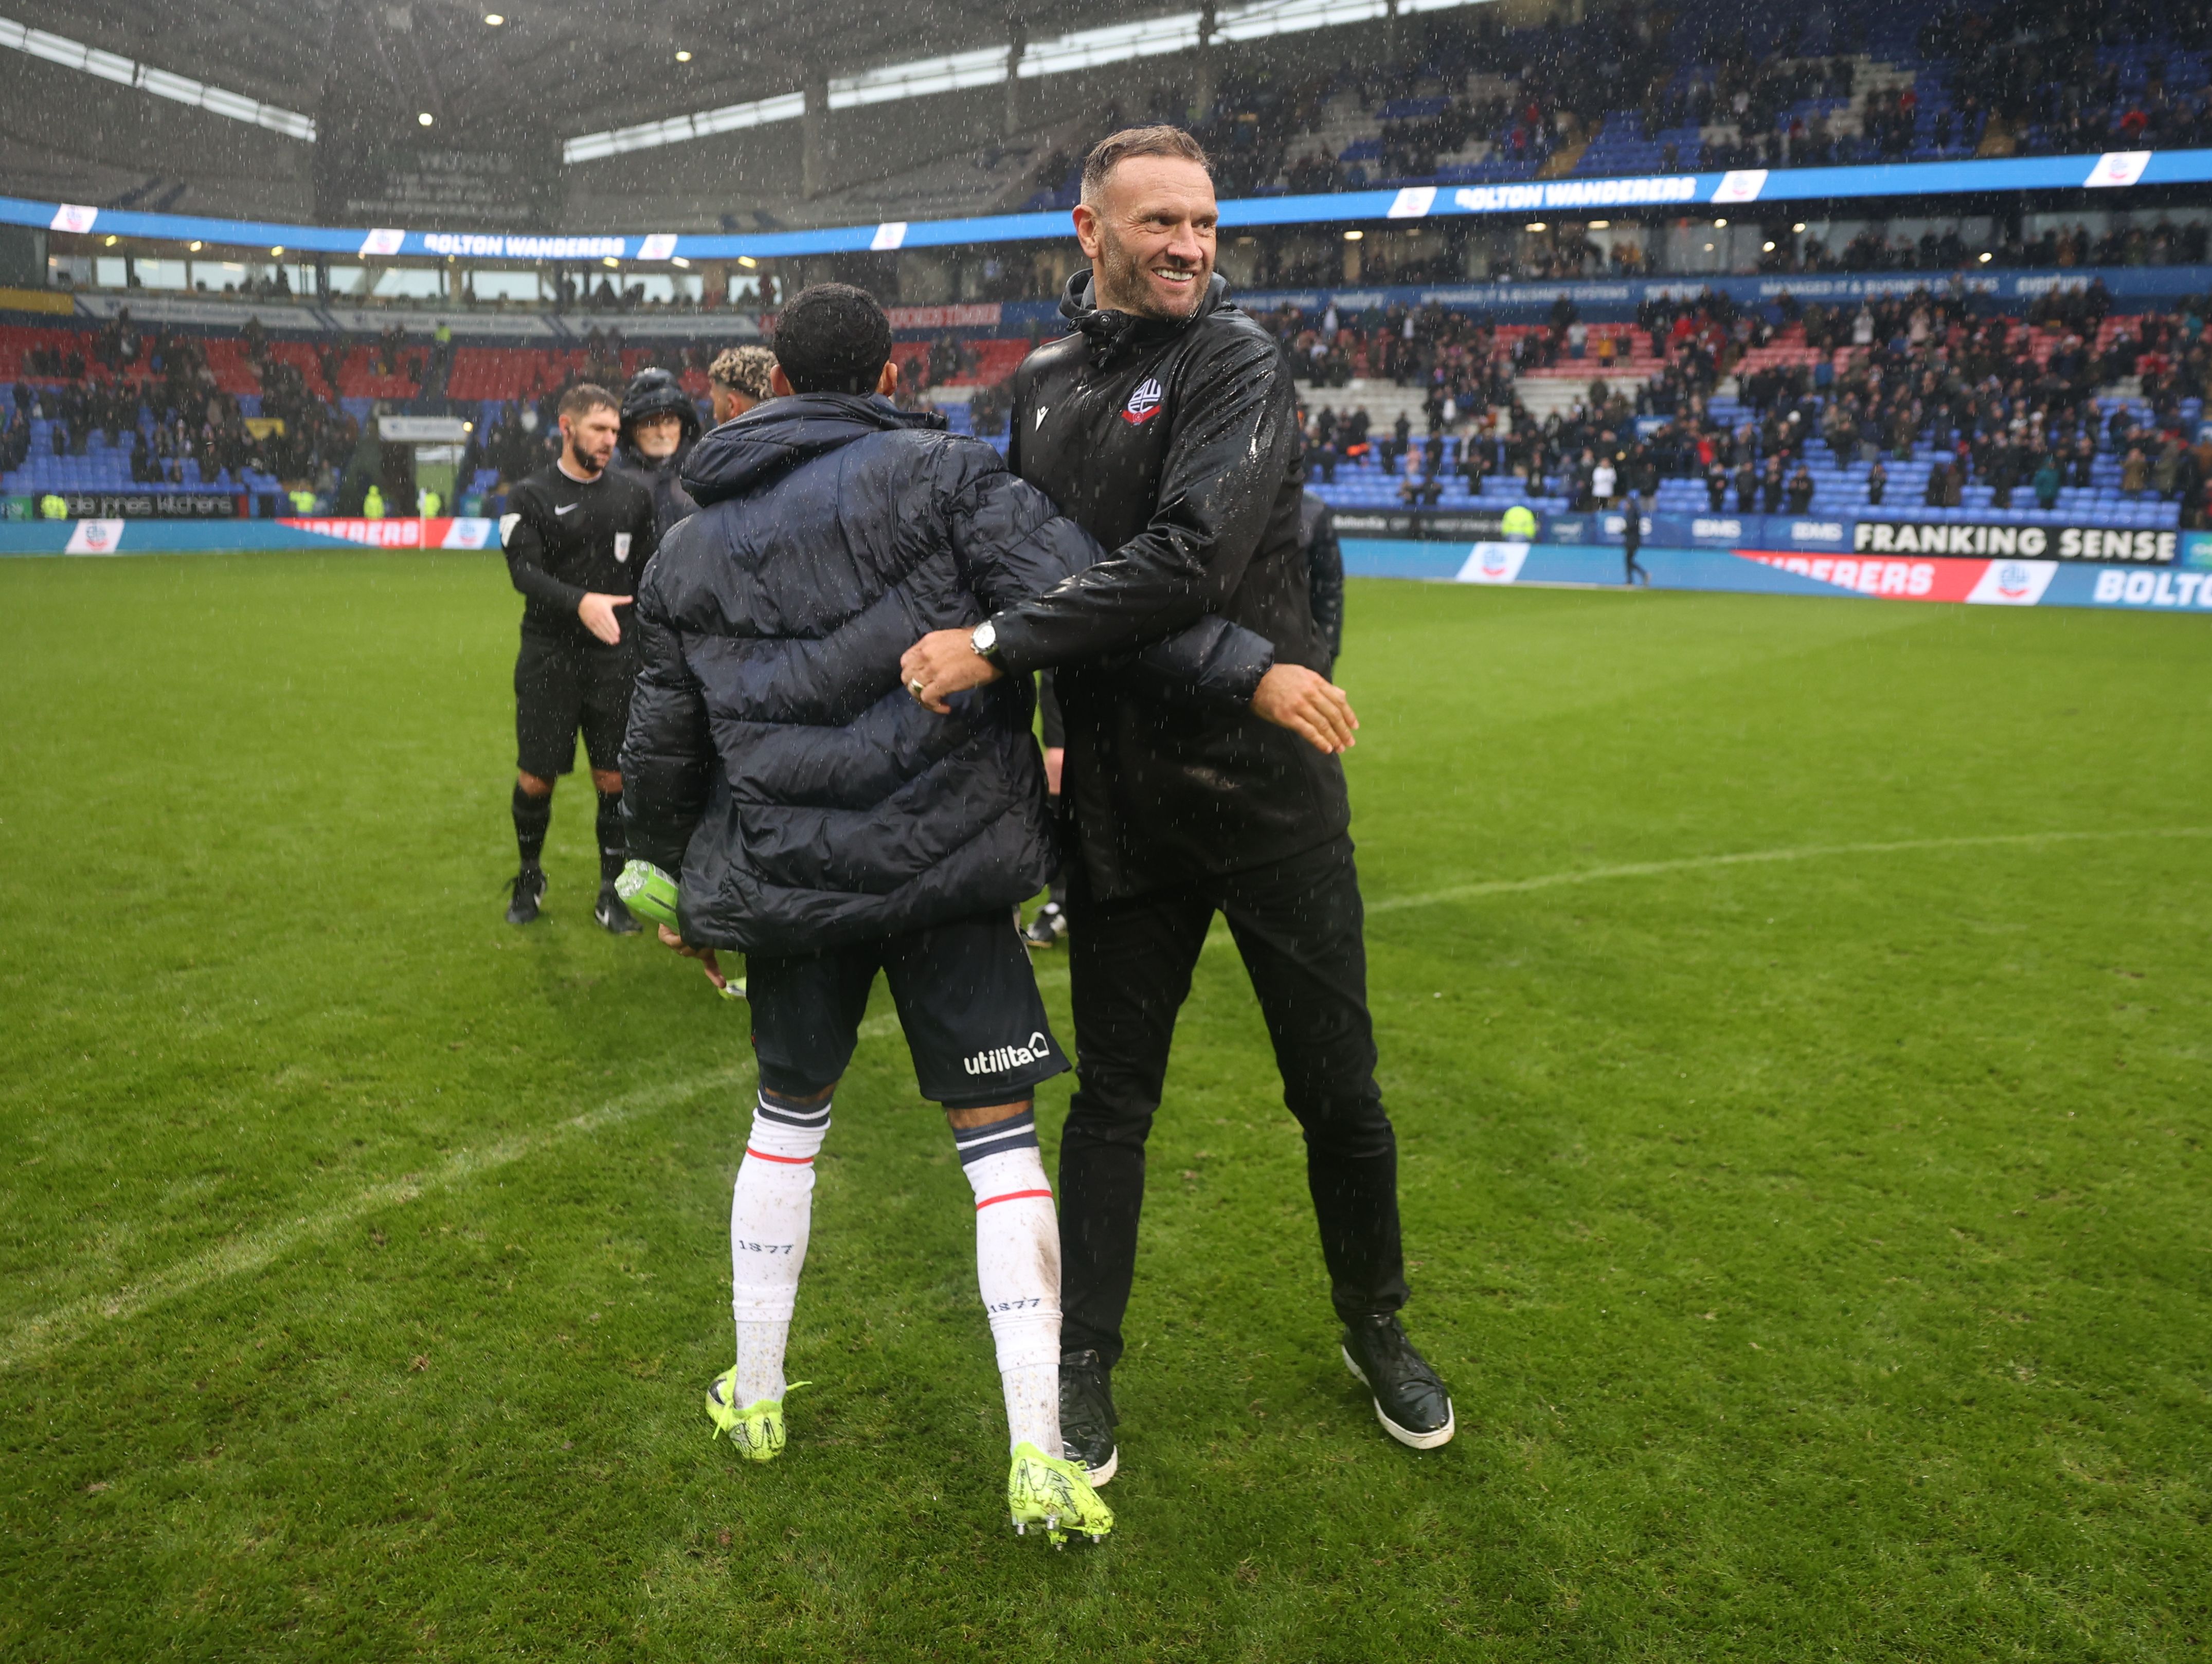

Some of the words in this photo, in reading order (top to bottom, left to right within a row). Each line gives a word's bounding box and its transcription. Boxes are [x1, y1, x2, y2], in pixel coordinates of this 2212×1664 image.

[1455, 186, 1542, 211] BOLTON
[1545, 176, 1697, 206] WANDERERS
[506, 237, 625, 257] WANDERERS
[1855, 523, 2047, 557] FRANKING
[2058, 528, 2177, 562] SENSE
[963, 1045, 1035, 1075] utilita
[739, 1240, 795, 1255] 1877
[990, 1298, 1041, 1313] 1877
